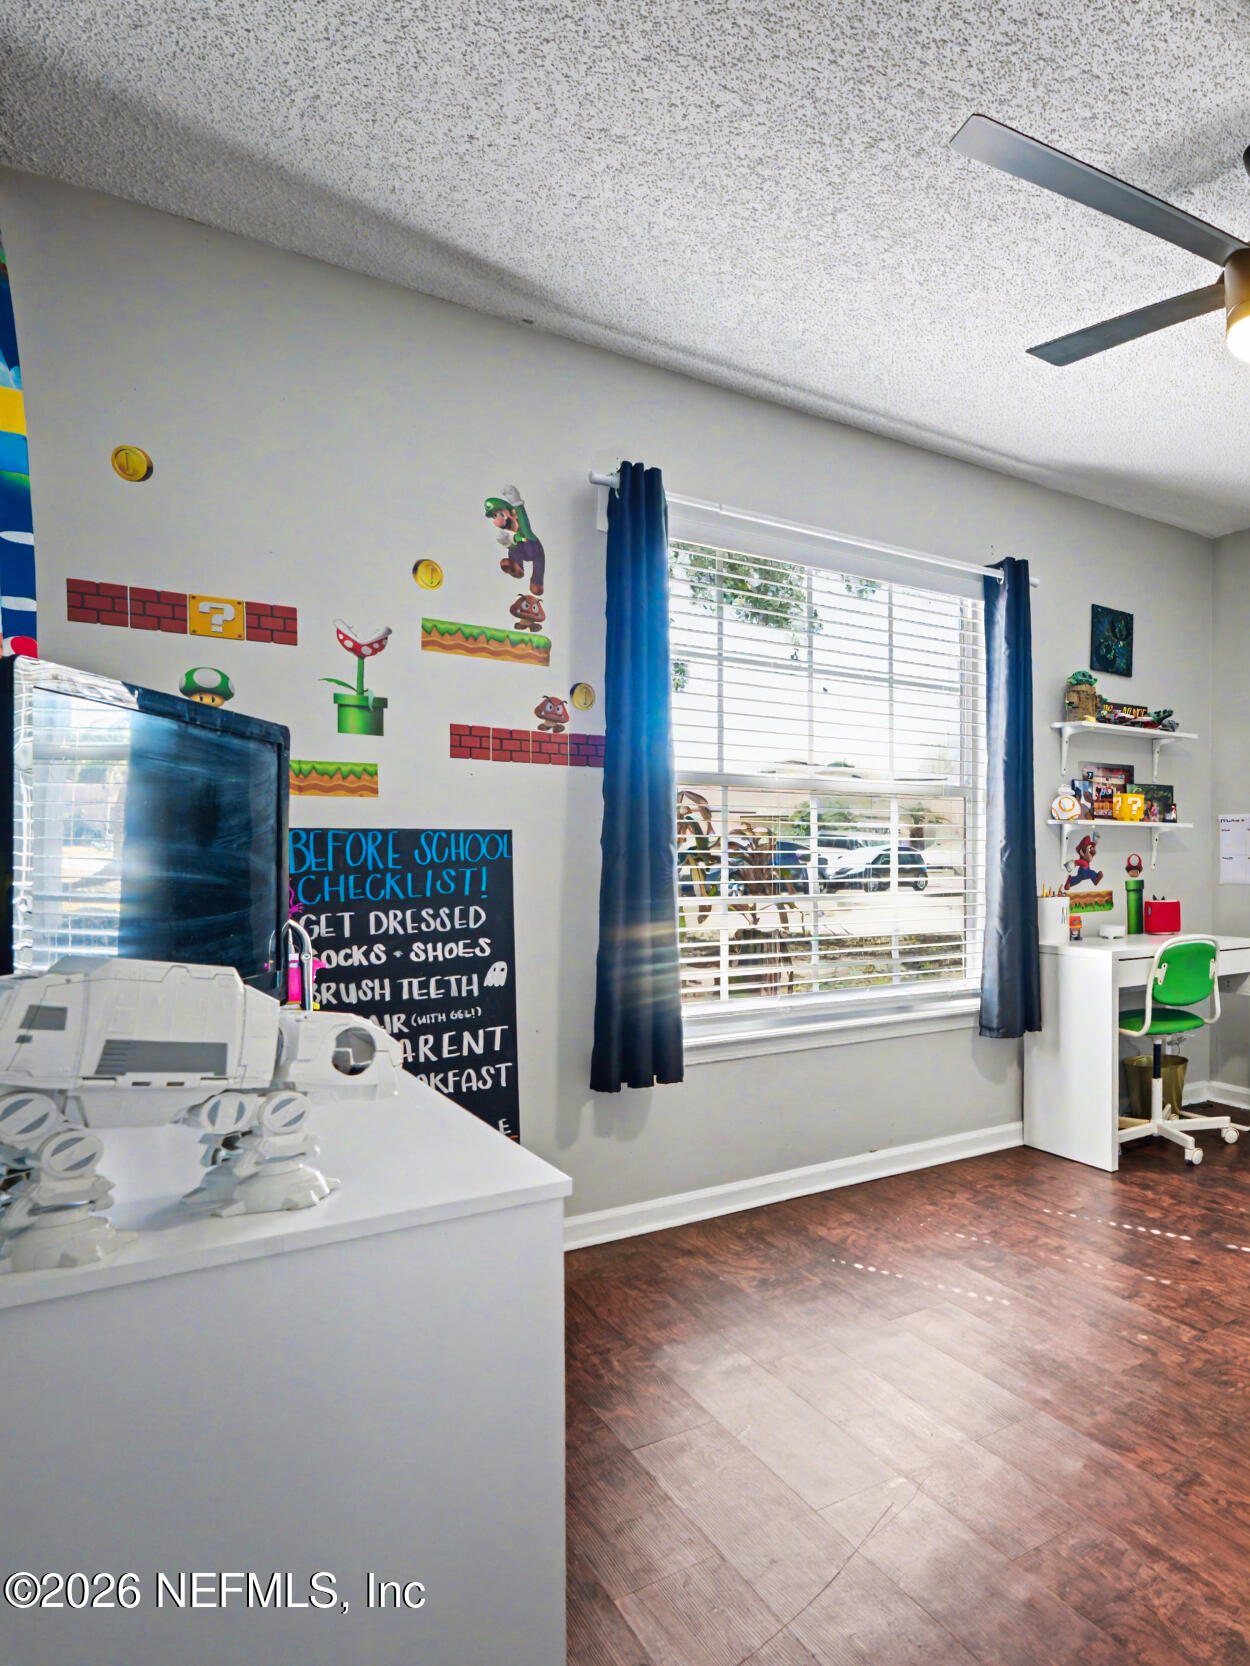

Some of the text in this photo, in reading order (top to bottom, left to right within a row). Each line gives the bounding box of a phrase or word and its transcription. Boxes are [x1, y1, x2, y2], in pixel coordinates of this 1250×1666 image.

[289, 829, 512, 874] BEFORE SCHOOL
[297, 866, 488, 905] CHECKLIST!
[300, 905, 487, 940] GET DRESSED
[410, 937, 492, 963] SHOES
[397, 973, 480, 1001] TEETH
[401, 1025, 509, 1063] ARENT
